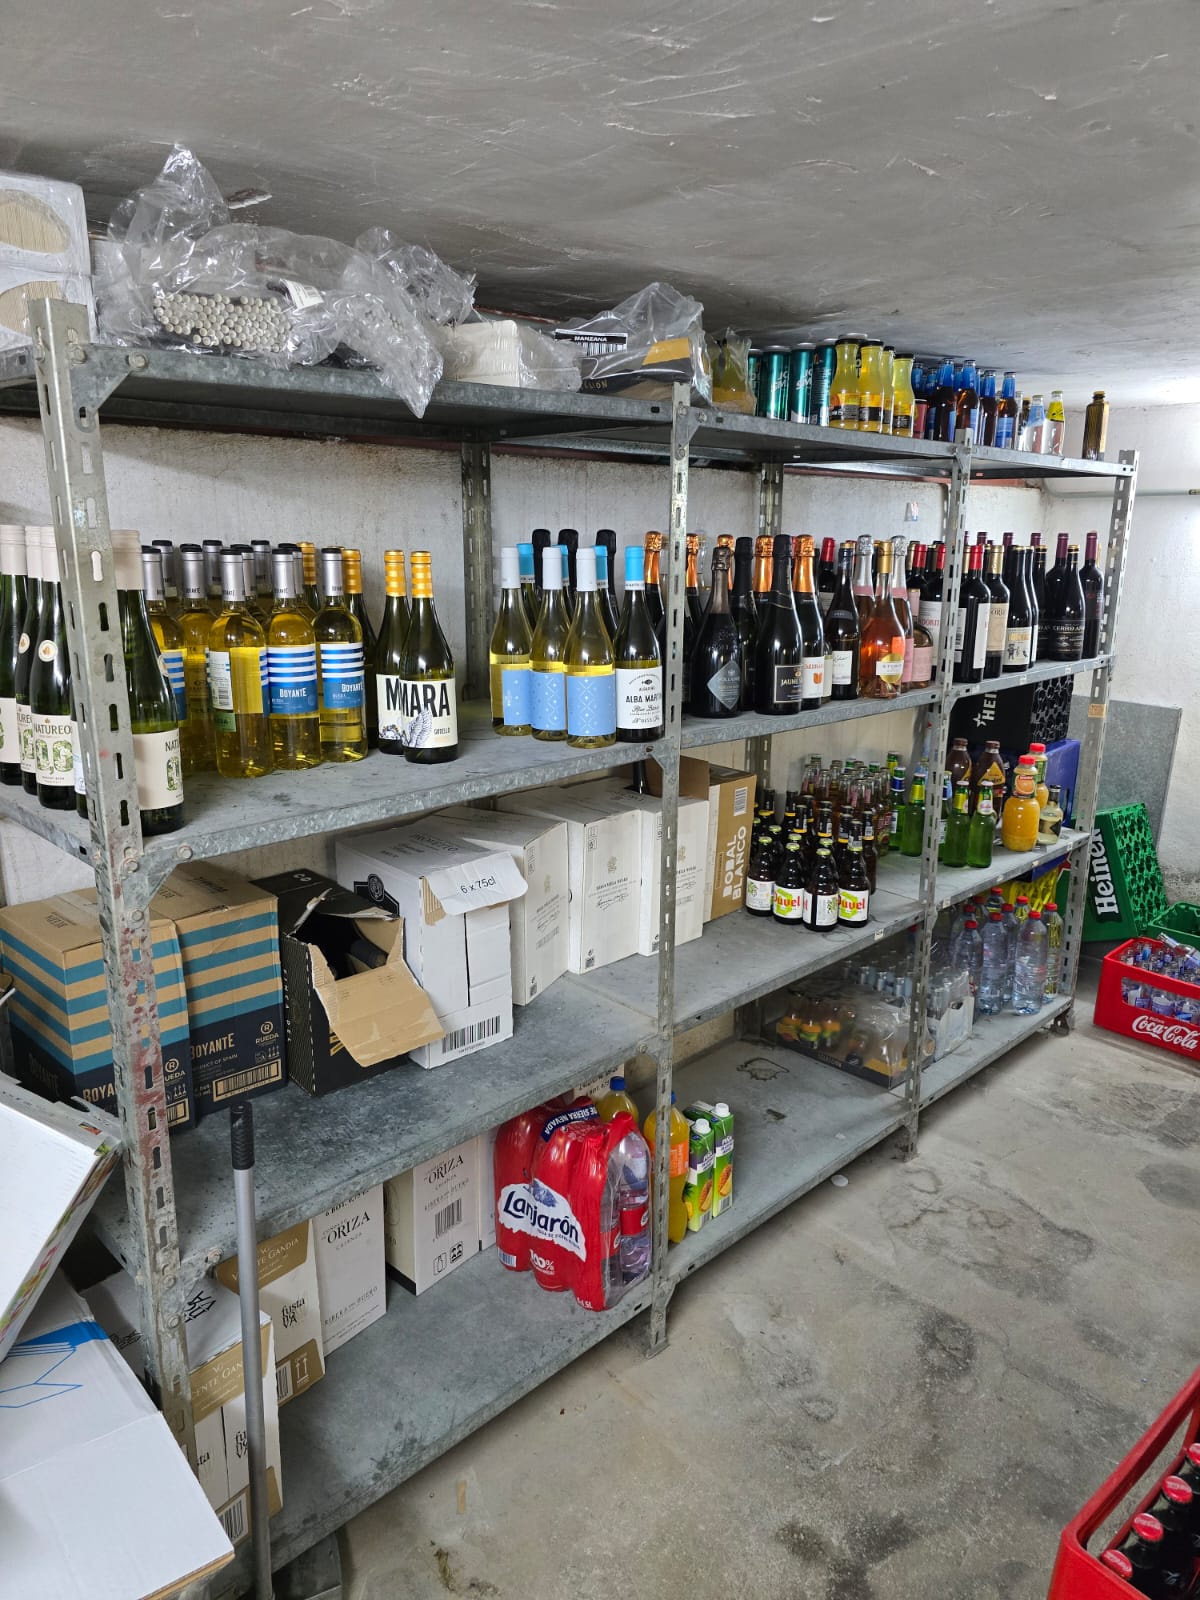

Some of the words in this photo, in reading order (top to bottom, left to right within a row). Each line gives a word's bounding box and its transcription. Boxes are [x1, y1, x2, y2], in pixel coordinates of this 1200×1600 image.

[279, 687, 307, 698] BOYANTE
[722, 834, 737, 898] BOBAL
[732, 825, 747, 900] BLANCO
[460, 885, 468, 894] 6
[470, 883, 477, 891] x
[477, 875, 497, 889] 75cl
[255, 1032, 280, 1045] RUEDA
[1132, 1015, 1200, 1050] Coca-Cola
[164, 1070, 187, 1082] UEDA
[82, 1082, 116, 1103] BOYA
[428, 1154, 464, 1184] ORIZA
[327, 1210, 371, 1244] ORIZA
[503, 1190, 579, 1243] Lanjarón
[267, 1237, 300, 1260] GANDIA
[221, 1361, 244, 1379] GAN
